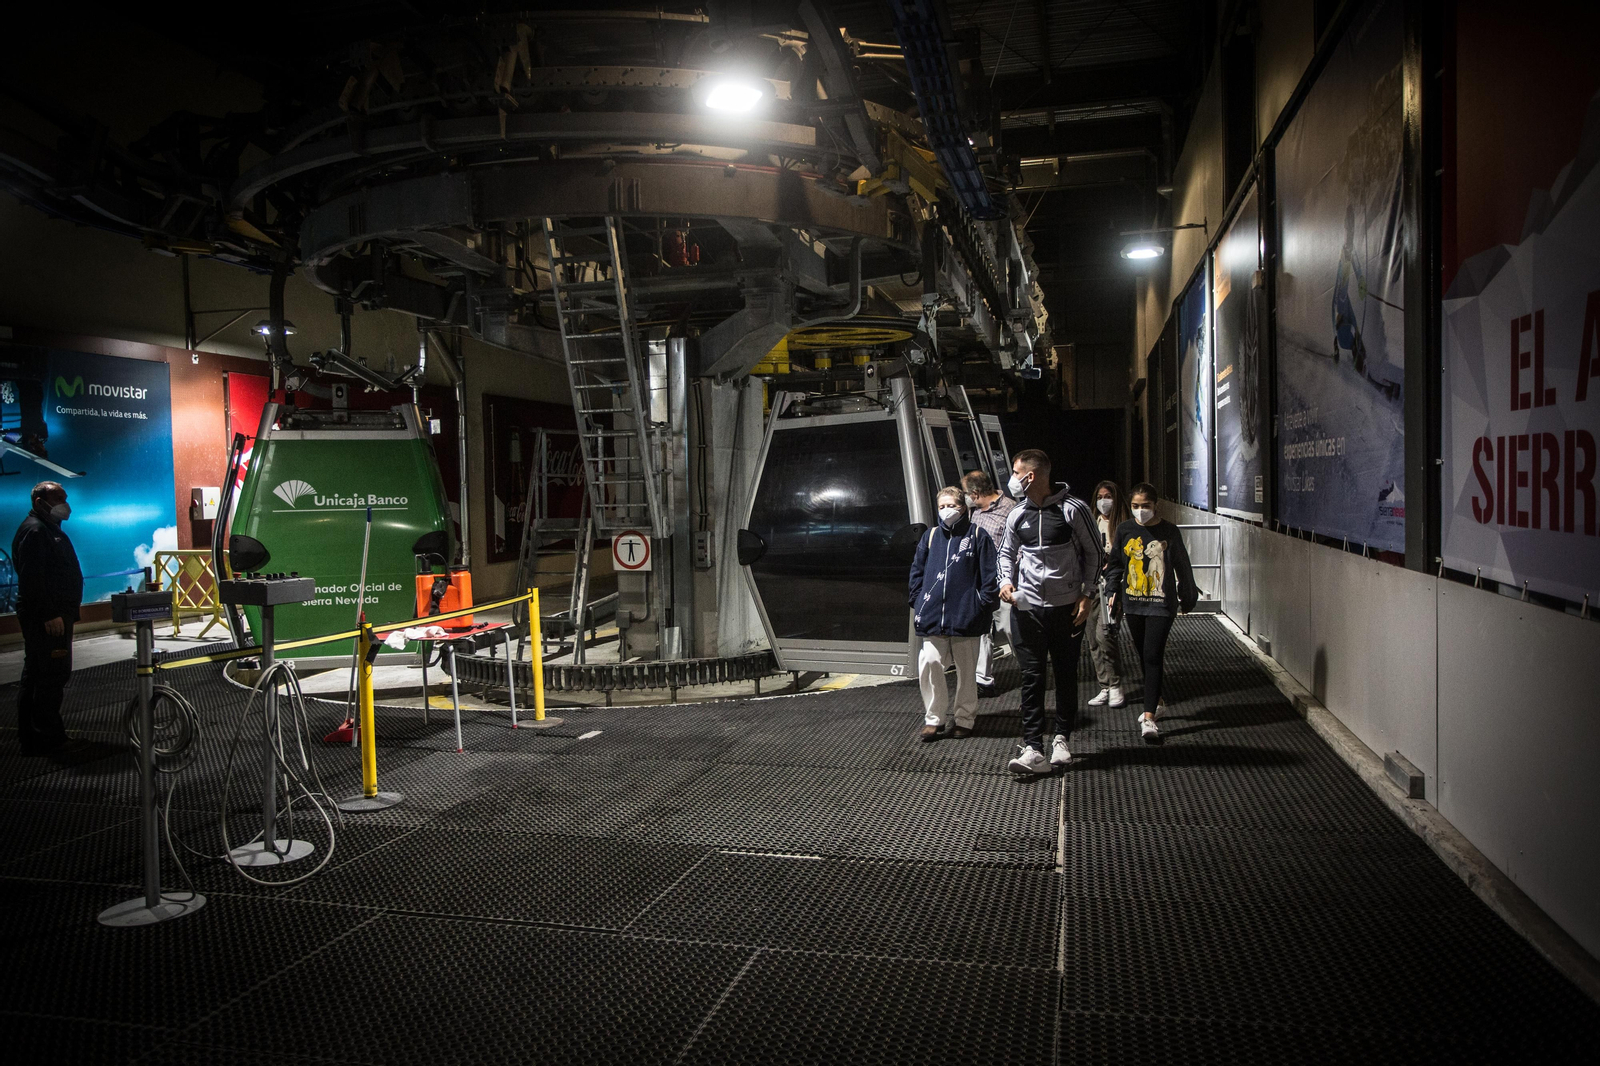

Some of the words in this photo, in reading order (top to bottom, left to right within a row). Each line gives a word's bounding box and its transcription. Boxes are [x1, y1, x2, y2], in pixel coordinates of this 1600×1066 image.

[1510, 308, 1556, 411] EL
[88, 383, 148, 400] movistar
[56, 405, 100, 417] Compartida,
[100, 408, 108, 417] la
[108, 409, 123, 419] vida
[123, 411, 131, 419] es
[132, 410, 148, 420] más.
[1336, 437, 1345, 456] en
[1471, 429, 1600, 537] SIERR
[314, 493, 366, 508] Unicaja
[367, 494, 408, 506] Banco
[388, 582, 402, 592] de
[890, 665, 905, 676] 67
